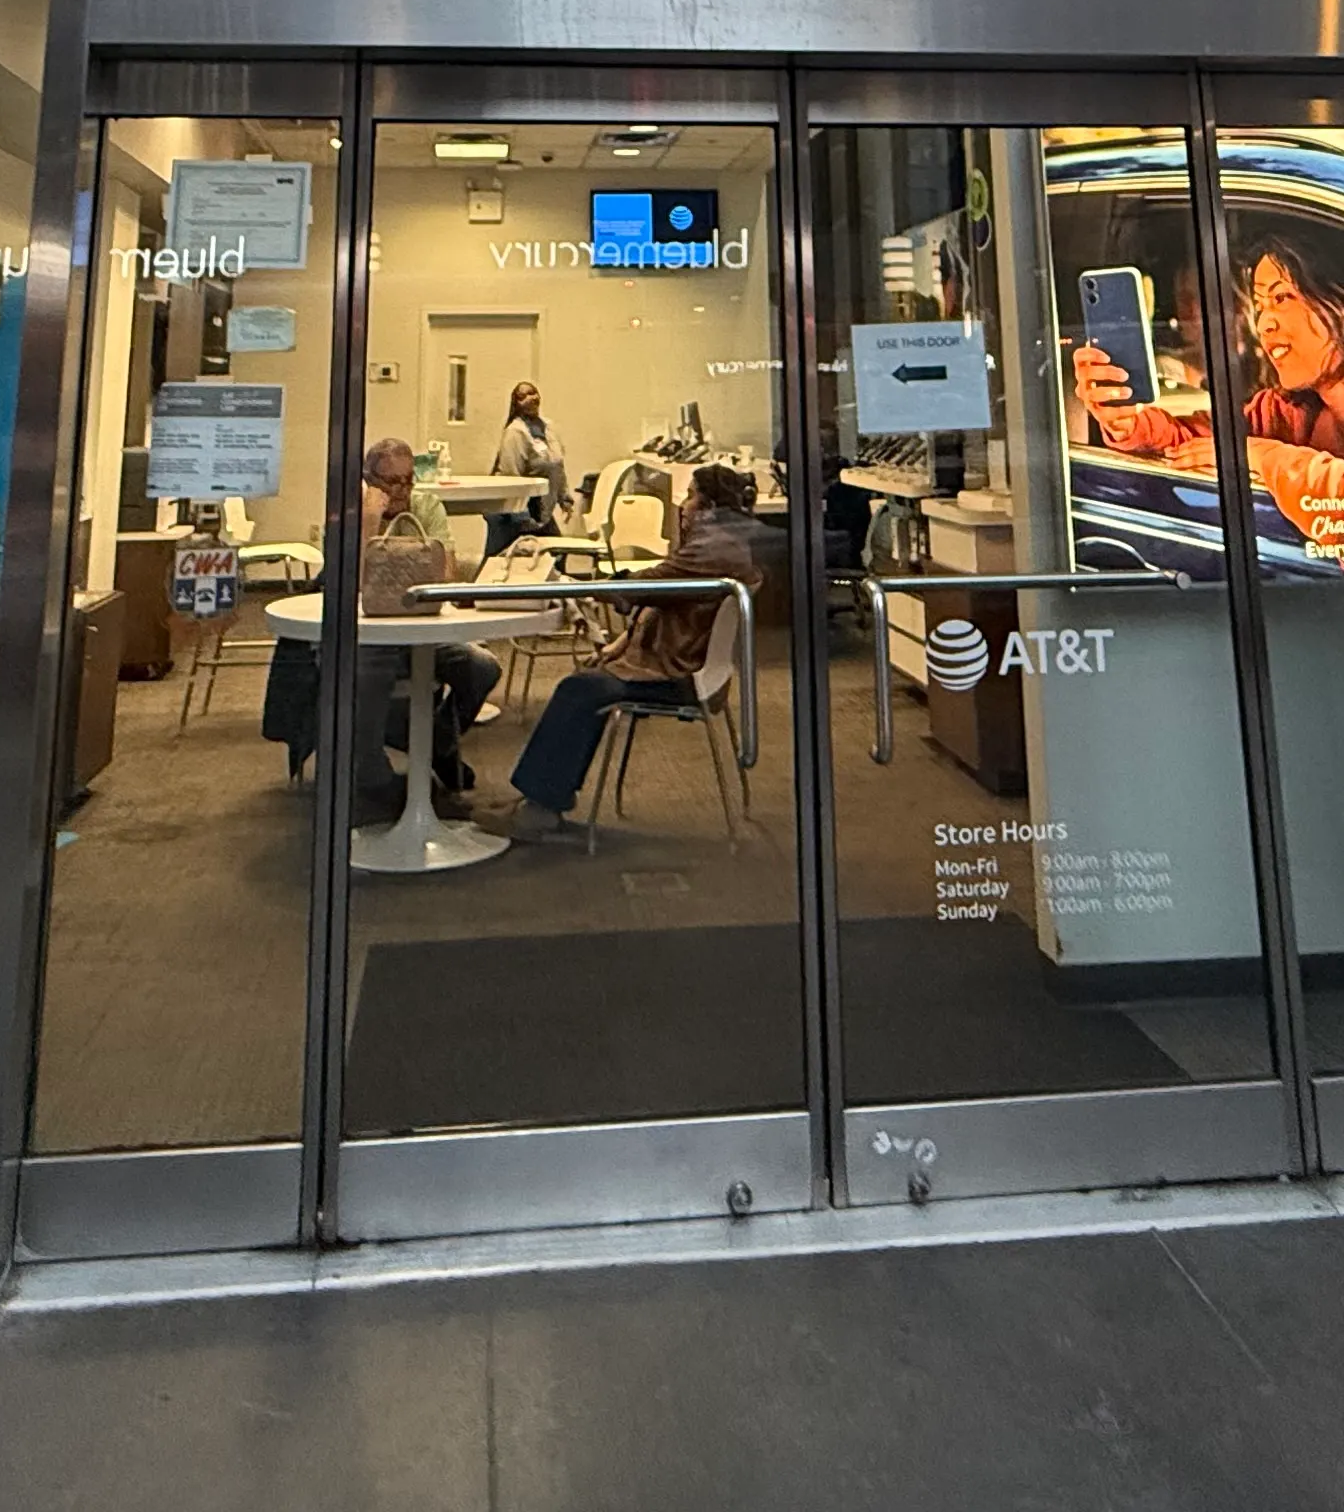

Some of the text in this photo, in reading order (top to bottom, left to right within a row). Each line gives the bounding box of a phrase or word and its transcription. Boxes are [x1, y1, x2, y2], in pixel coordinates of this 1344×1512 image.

[877, 335, 960, 349] USE THIS DOOR
[179, 550, 233, 576] CWA
[998, 629, 1116, 676] AT&T
[934, 819, 1068, 846] Store Hours
[935, 855, 999, 876] Mon-Fri
[936, 878, 1009, 899] Saturday
[937, 901, 998, 922] Sunday
